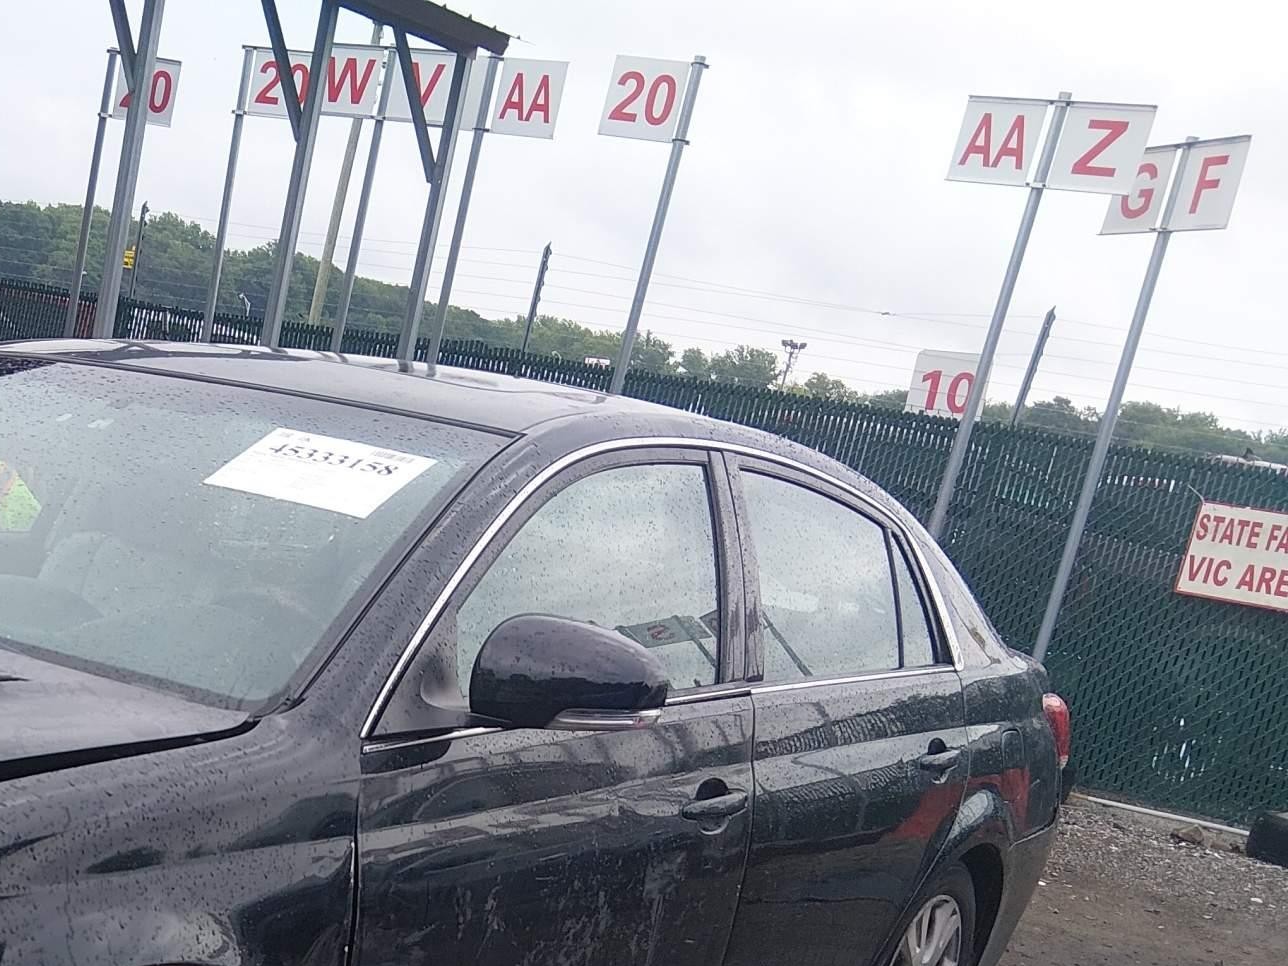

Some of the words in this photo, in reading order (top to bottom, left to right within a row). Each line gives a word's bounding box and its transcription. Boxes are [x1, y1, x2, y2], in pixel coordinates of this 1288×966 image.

[119, 70, 172, 113] 0
[327, 57, 376, 104] W
[411, 62, 446, 108] V
[499, 72, 550, 124] AA
[608, 71, 676, 126] 20
[958, 112, 1026, 170] AA
[1071, 119, 1129, 177] Z
[1120, 163, 1158, 219] G
[1189, 155, 1229, 214] F
[922, 370, 974, 413] 10
[269, 444, 399, 476] 45333158
[1196, 513, 1264, 549] STATE
[1188, 554, 1232, 587] VIC
[1235, 564, 1288, 597] ARE
